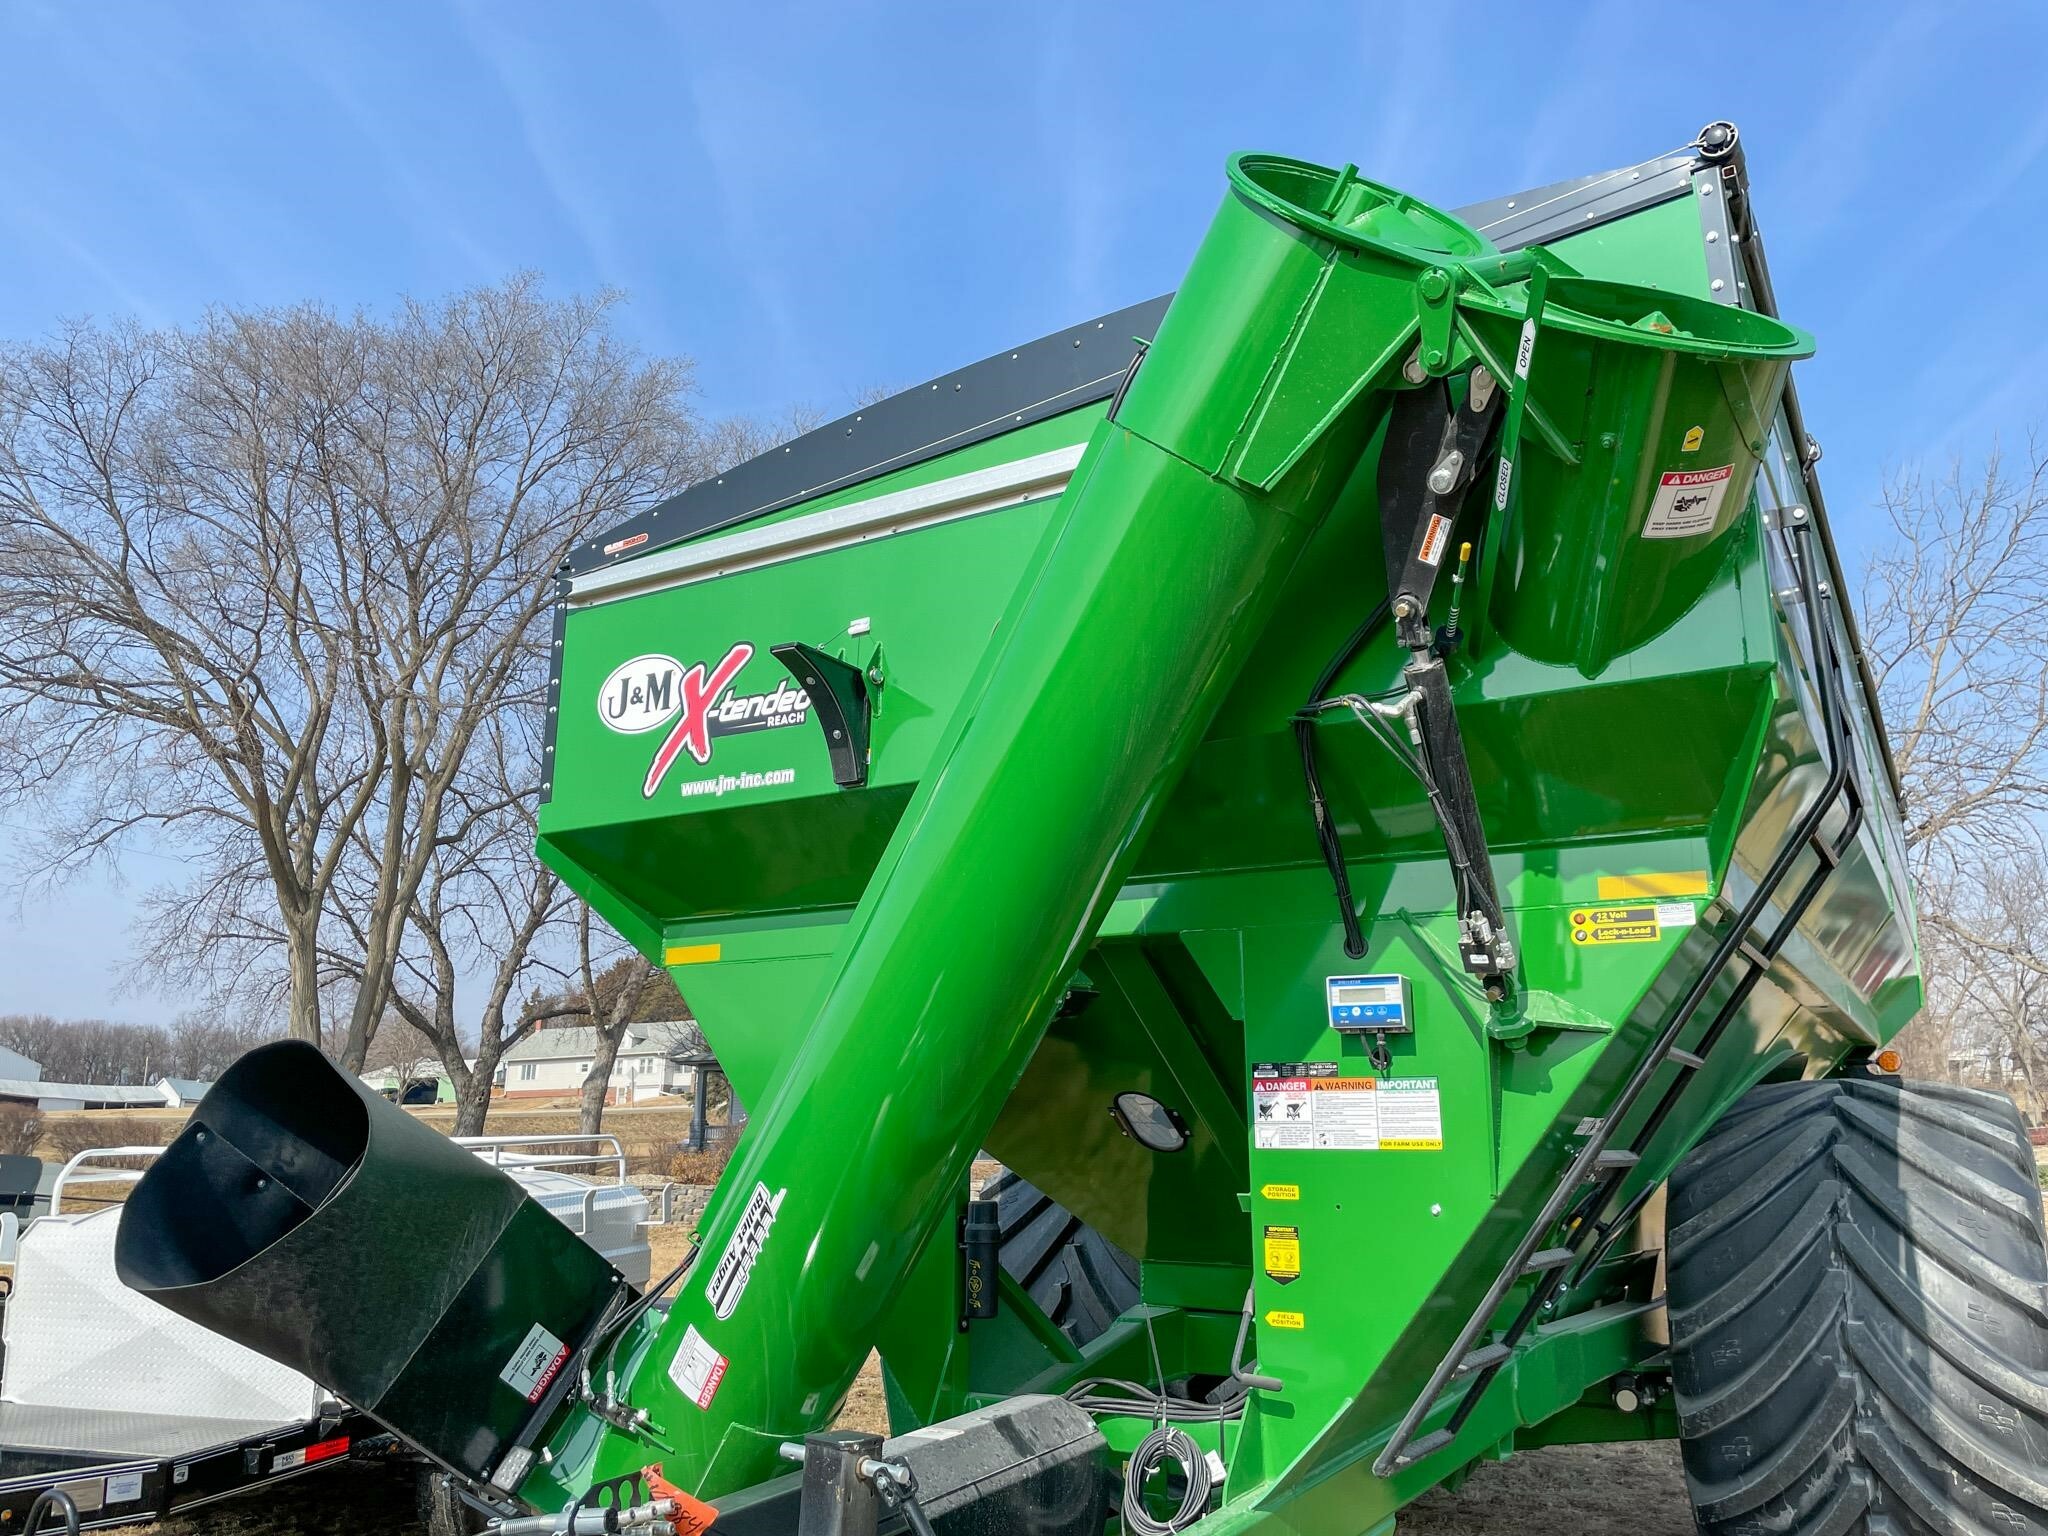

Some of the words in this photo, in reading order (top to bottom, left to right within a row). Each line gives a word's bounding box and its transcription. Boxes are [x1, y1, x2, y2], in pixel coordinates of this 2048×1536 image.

[1519, 335, 1532, 368] OPEN
[1497, 462, 1509, 504] CLOSED
[1682, 469, 1728, 484] DANGER
[1426, 518, 1439, 550] WARNING
[608, 669, 674, 719] J&M
[767, 712, 805, 727] REACH
[681, 768, 795, 797] www.jm-inc.com
[1596, 912, 1608, 920] 12
[1609, 911, 1628, 919] Volt
[1597, 926, 1651, 936] Lock-n-Load
[1265, 1082, 1307, 1091] DANGER
[1325, 1081, 1373, 1090] WARNING
[1376, 1079, 1437, 1090] IMPORTANT
[736, 1190, 765, 1244] Bullet
[711, 1243, 739, 1299] Auger
[529, 1358, 562, 1401] DANGER
[699, 1367, 723, 1408] DANGER
